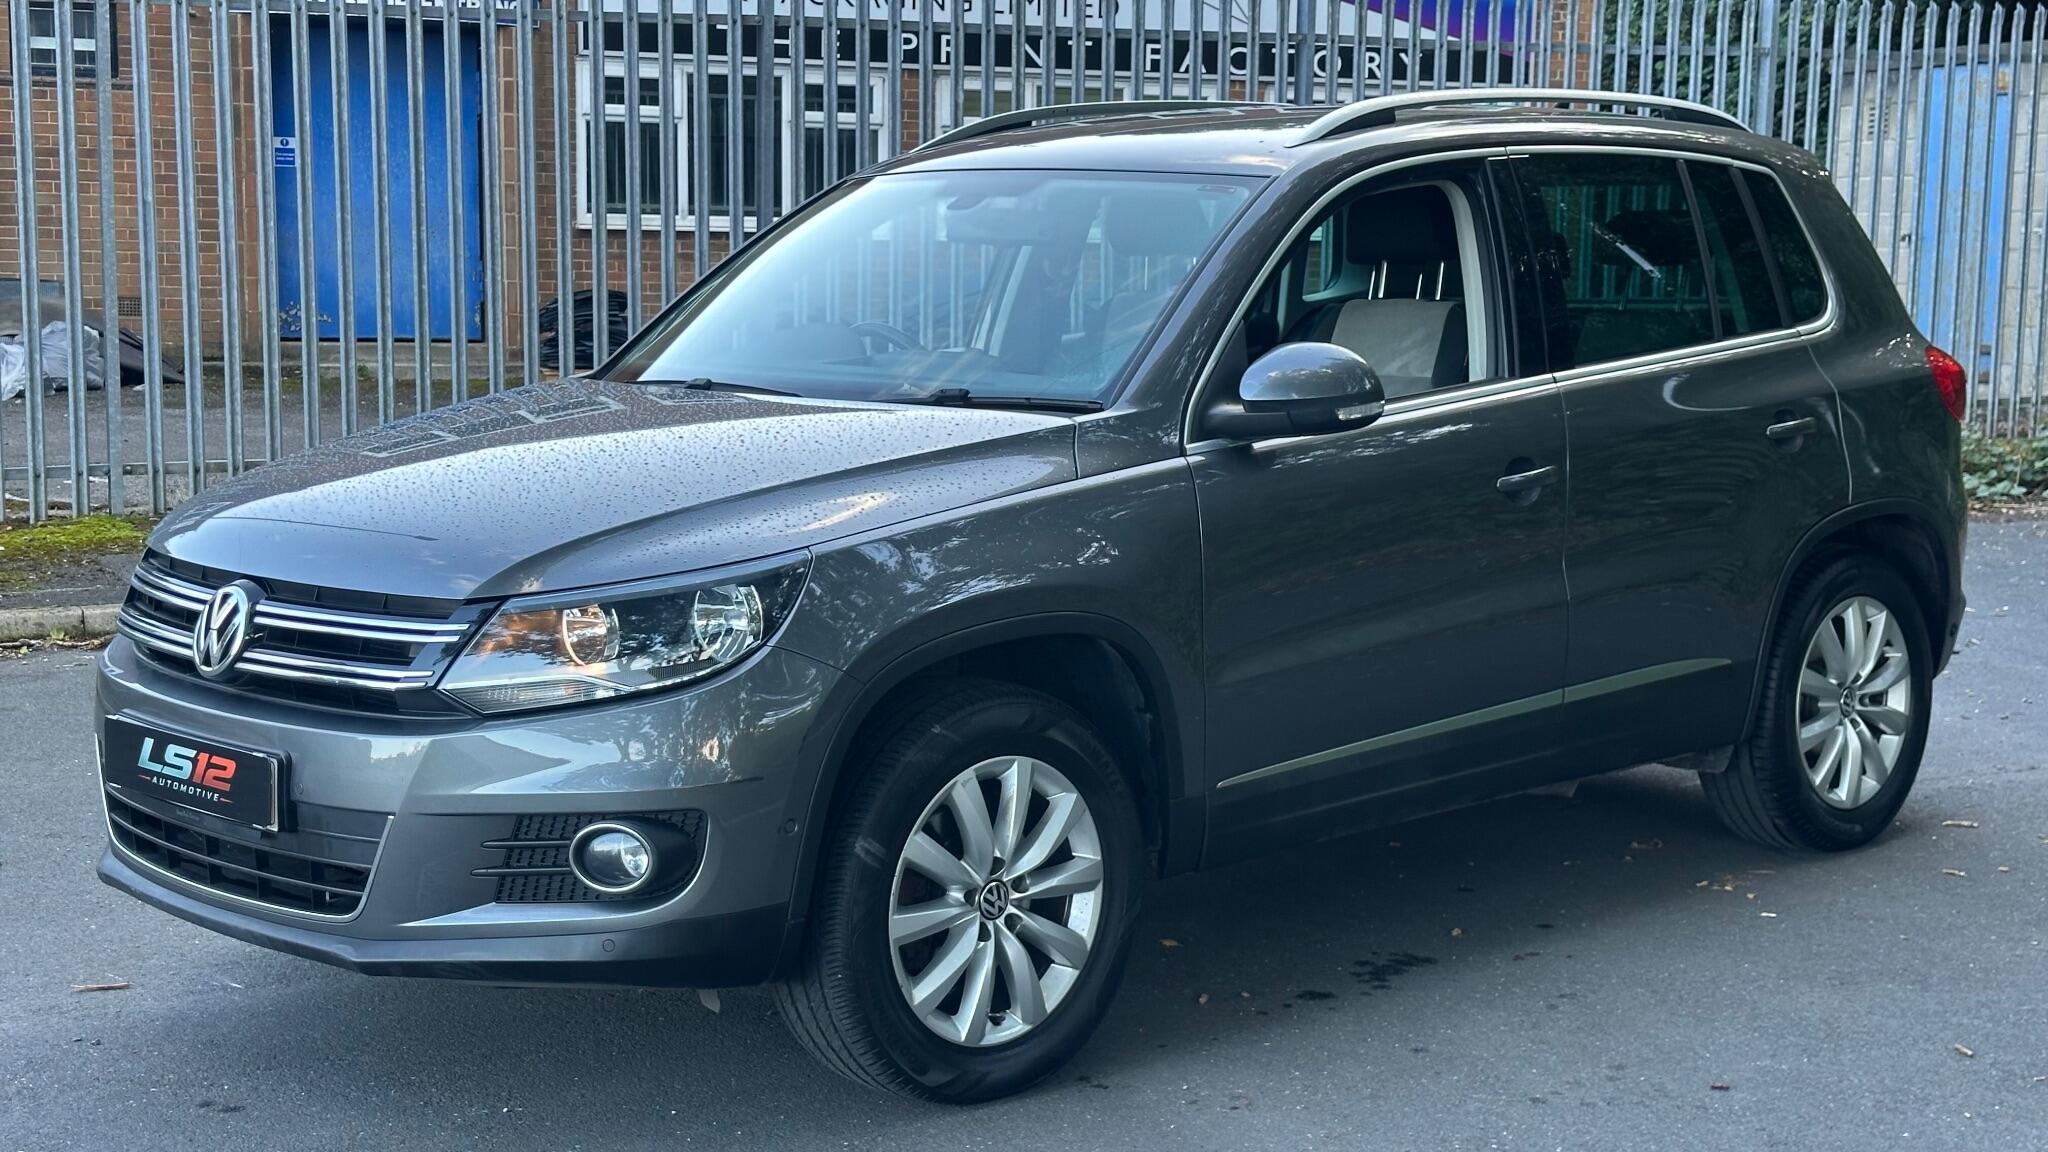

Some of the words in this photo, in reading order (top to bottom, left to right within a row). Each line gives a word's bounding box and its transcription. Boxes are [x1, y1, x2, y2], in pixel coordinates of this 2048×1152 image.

[901, 33, 1093, 68] PRN
[137, 736, 237, 792] LS12
[151, 775, 220, 802] AUTOMOTIVE
